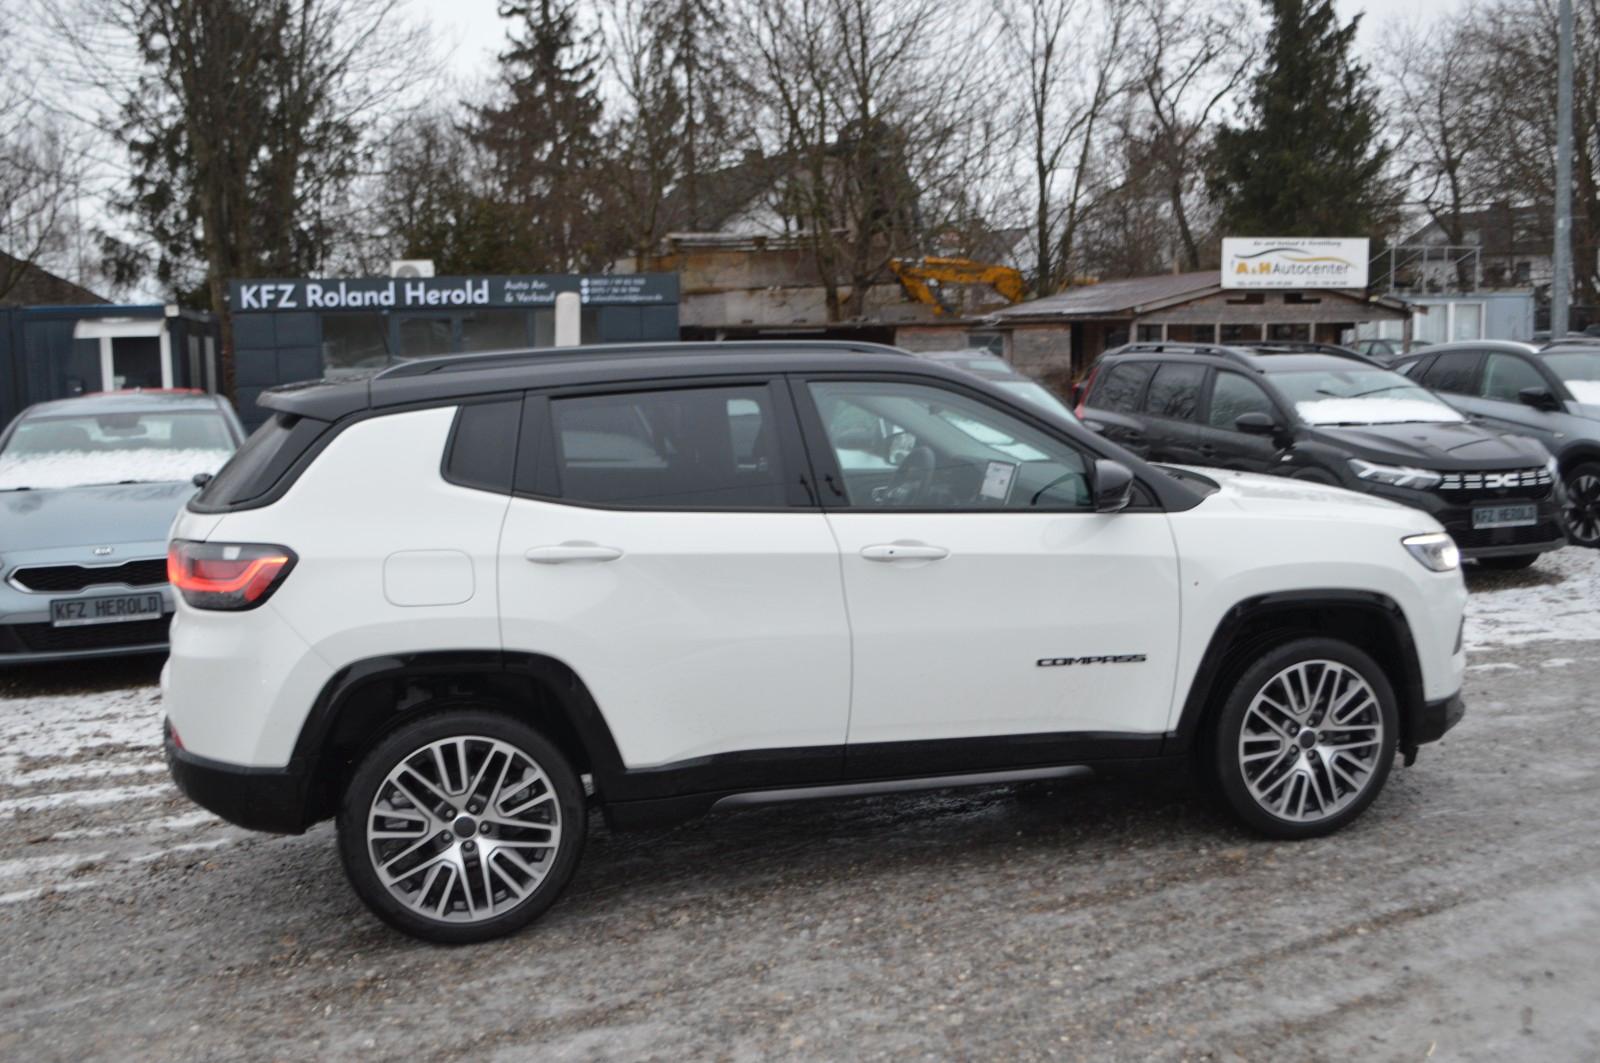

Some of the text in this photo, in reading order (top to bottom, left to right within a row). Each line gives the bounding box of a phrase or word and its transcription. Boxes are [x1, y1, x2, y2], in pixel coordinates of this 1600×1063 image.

[1272, 263, 1349, 275] Autocenter
[504, 280, 529, 290] Auto
[240, 279, 489, 309] KFZ Roland Herold
[55, 596, 158, 619] KFZ HEROLD
[1037, 654, 1147, 667] COMPASS
